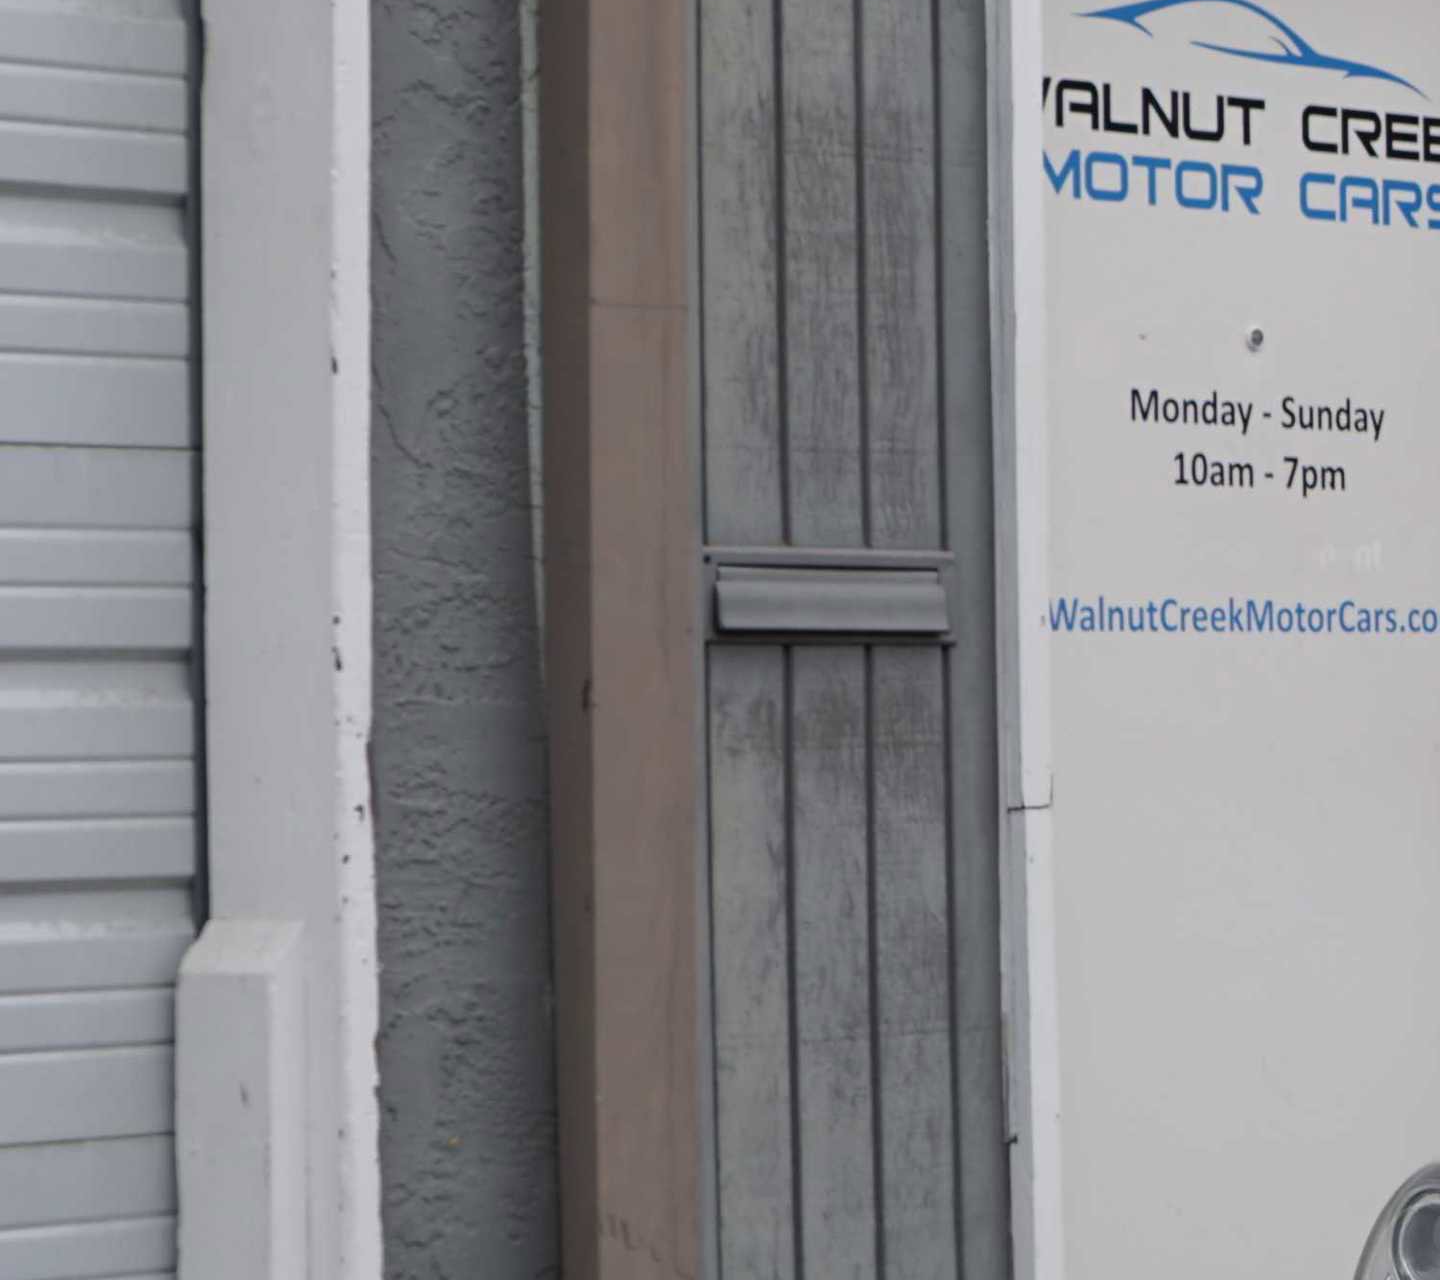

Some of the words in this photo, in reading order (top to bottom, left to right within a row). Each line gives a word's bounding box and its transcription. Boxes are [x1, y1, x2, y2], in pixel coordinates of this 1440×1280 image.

[1042, 76, 1266, 146] ALNUT
[1042, 149, 1264, 214] MOTOR
[1129, 388, 1254, 437] Monday
[1280, 395, 1386, 441] Sunday
[1174, 451, 1255, 489] 10am
[1282, 456, 1347, 499] 7pm
